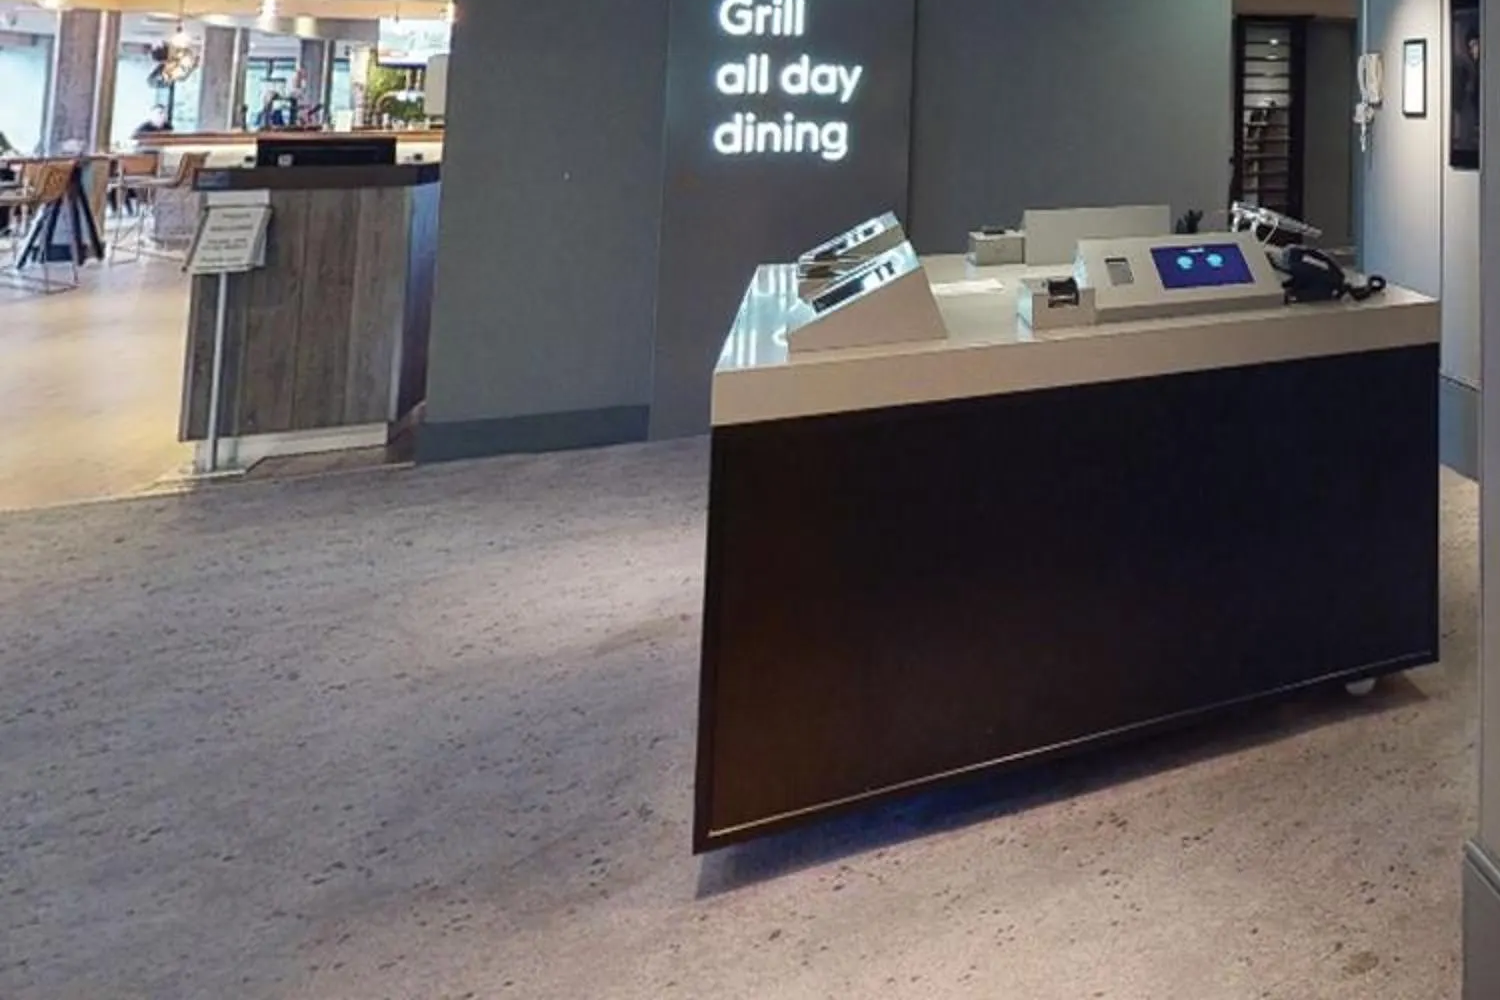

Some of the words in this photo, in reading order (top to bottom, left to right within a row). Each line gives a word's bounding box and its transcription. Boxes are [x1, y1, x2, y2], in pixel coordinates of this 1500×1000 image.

[715, 53, 770, 95] all
[779, 53, 864, 104] day
[712, 111, 849, 161] dining
